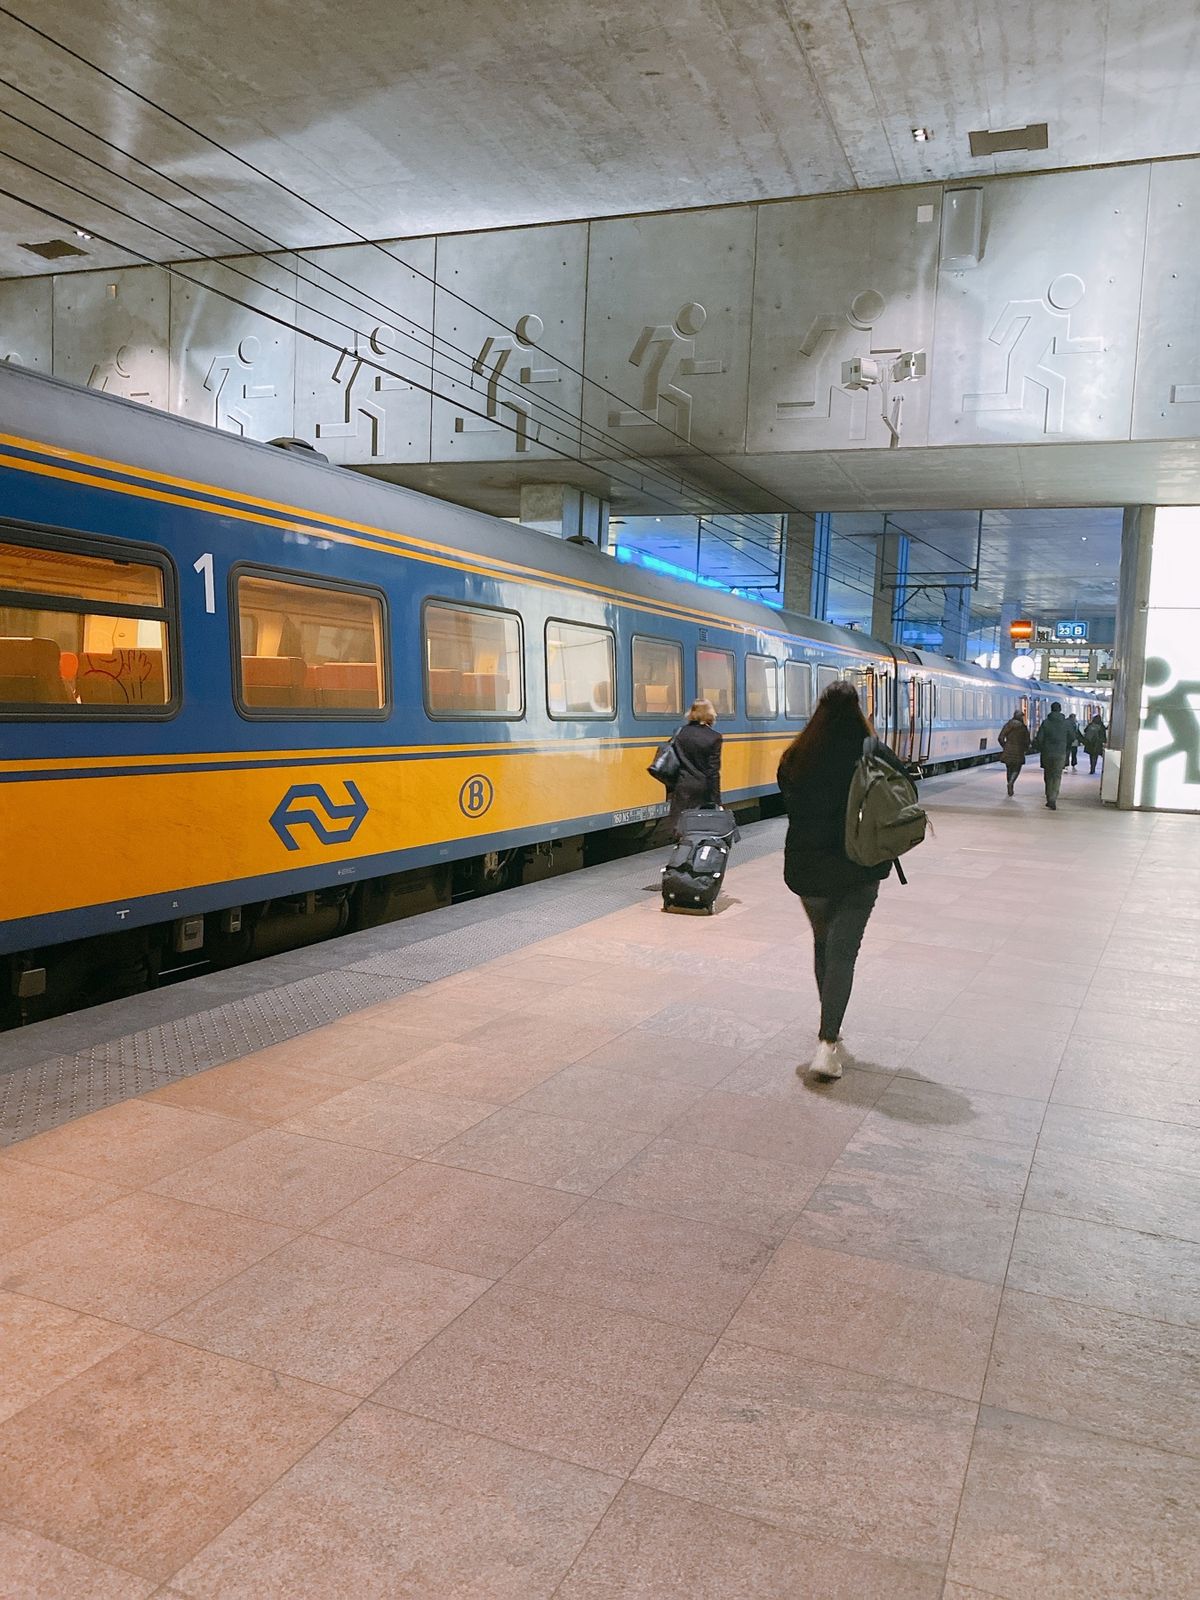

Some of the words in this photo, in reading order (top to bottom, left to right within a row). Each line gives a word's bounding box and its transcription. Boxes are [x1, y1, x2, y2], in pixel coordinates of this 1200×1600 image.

[193, 552, 215, 614] 1
[1059, 627, 1070, 635] 23
[1074, 626, 1082, 635] B
[468, 780, 484, 811] B
